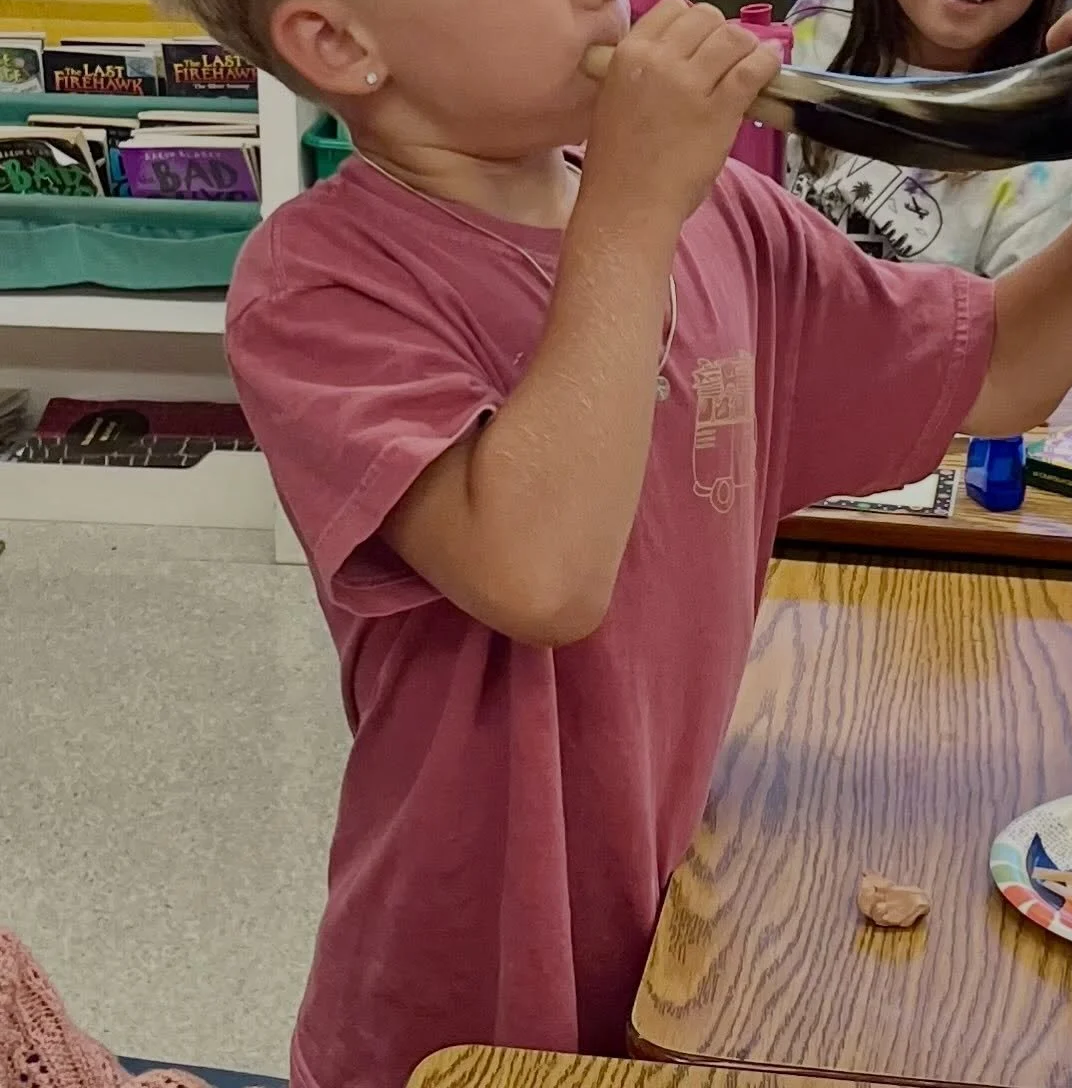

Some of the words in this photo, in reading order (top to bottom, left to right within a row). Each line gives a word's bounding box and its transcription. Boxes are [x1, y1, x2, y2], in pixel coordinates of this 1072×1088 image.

[64, 67, 81, 76] The
[83, 63, 124, 77] LAST
[182, 59, 200, 68] The
[202, 55, 242, 68] LAST
[55, 71, 143, 94] FIREHAWK
[152, 160, 238, 194] BAD
